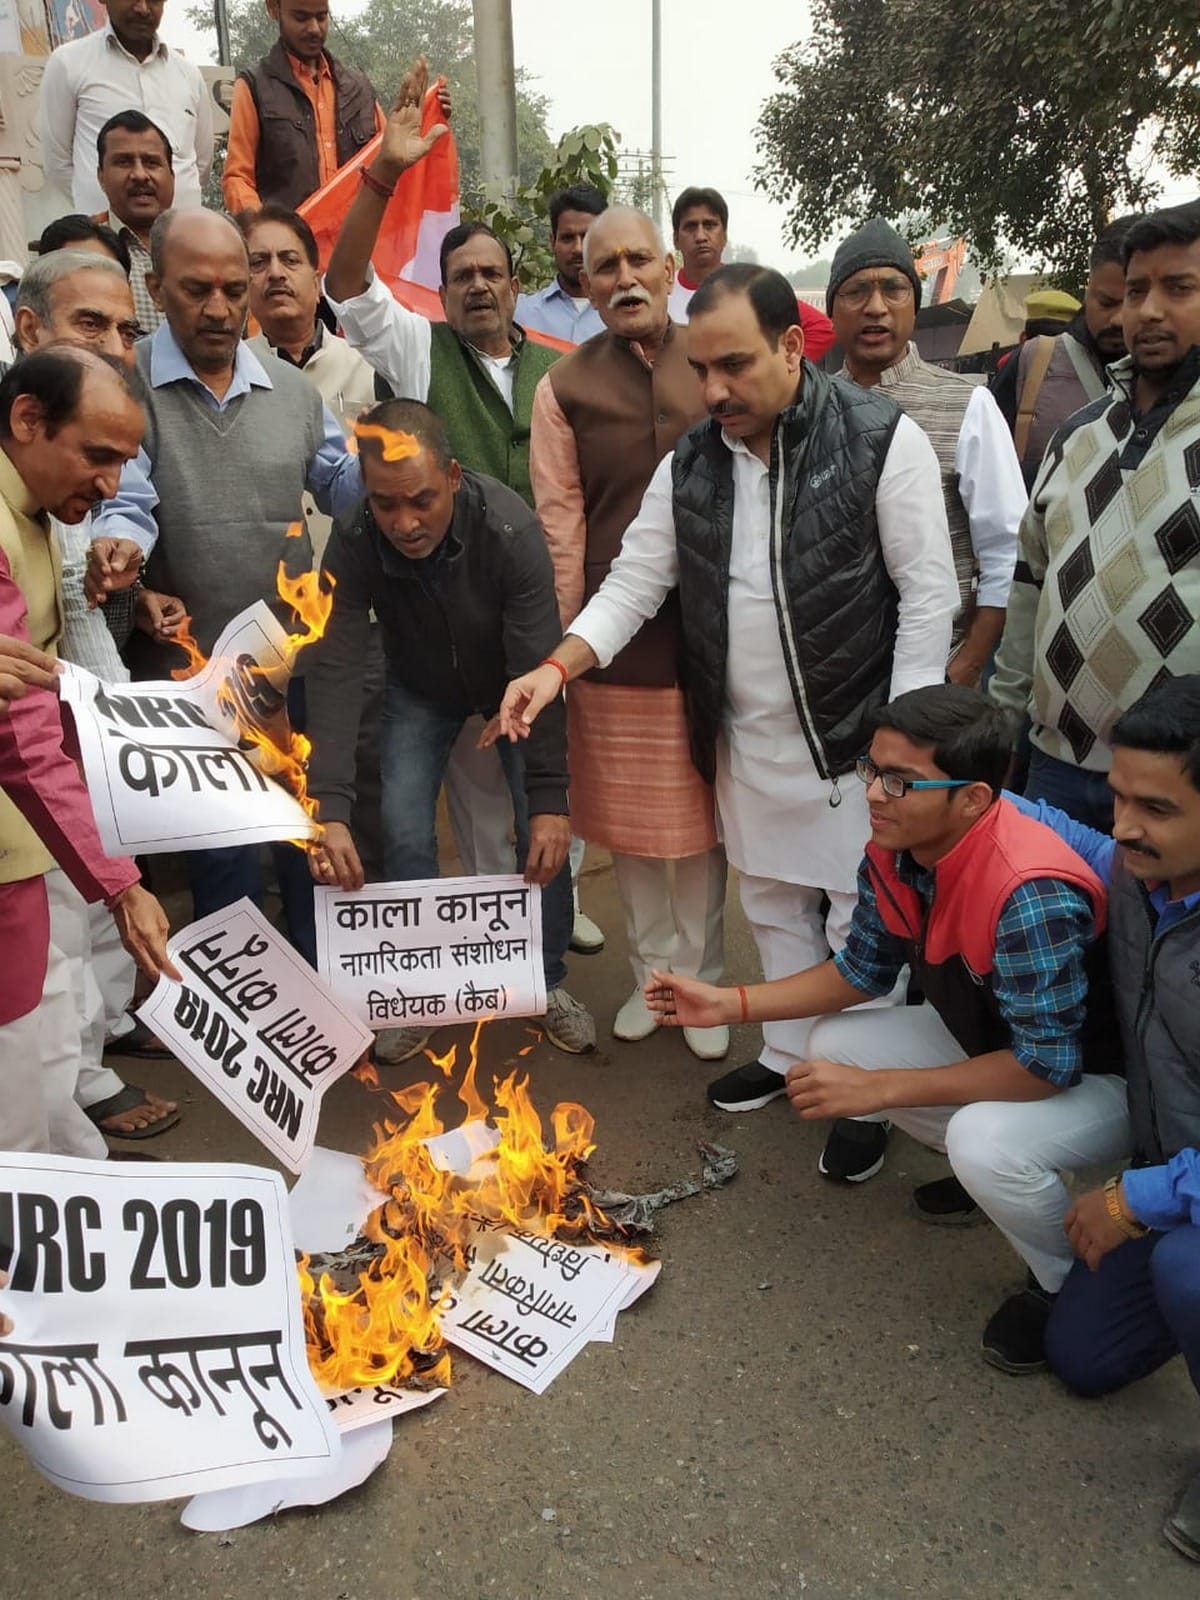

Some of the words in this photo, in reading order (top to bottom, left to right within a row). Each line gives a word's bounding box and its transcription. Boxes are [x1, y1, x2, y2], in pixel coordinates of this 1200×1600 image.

[108, 728, 269, 797] काला
[334, 897, 422, 930] काला
[435, 888, 529, 931] कानून
[178, 930, 278, 1024] कानून
[340, 941, 442, 977] नागरिकता
[450, 933, 528, 967] संशोधन
[173, 984, 248, 1079] 2019
[367, 988, 446, 1021] विधेयक
[455, 980, 508, 1015] (कैब)
[256, 1008, 338, 1090] काला
[246, 1056, 304, 1142] NRC
[122, 1198, 267, 1290] 2019
[478, 1259, 577, 1328] नागरिकता
[456, 1310, 549, 1368] काला
[0, 1342, 128, 1430] ाला
[123, 1330, 303, 1450] कानून
